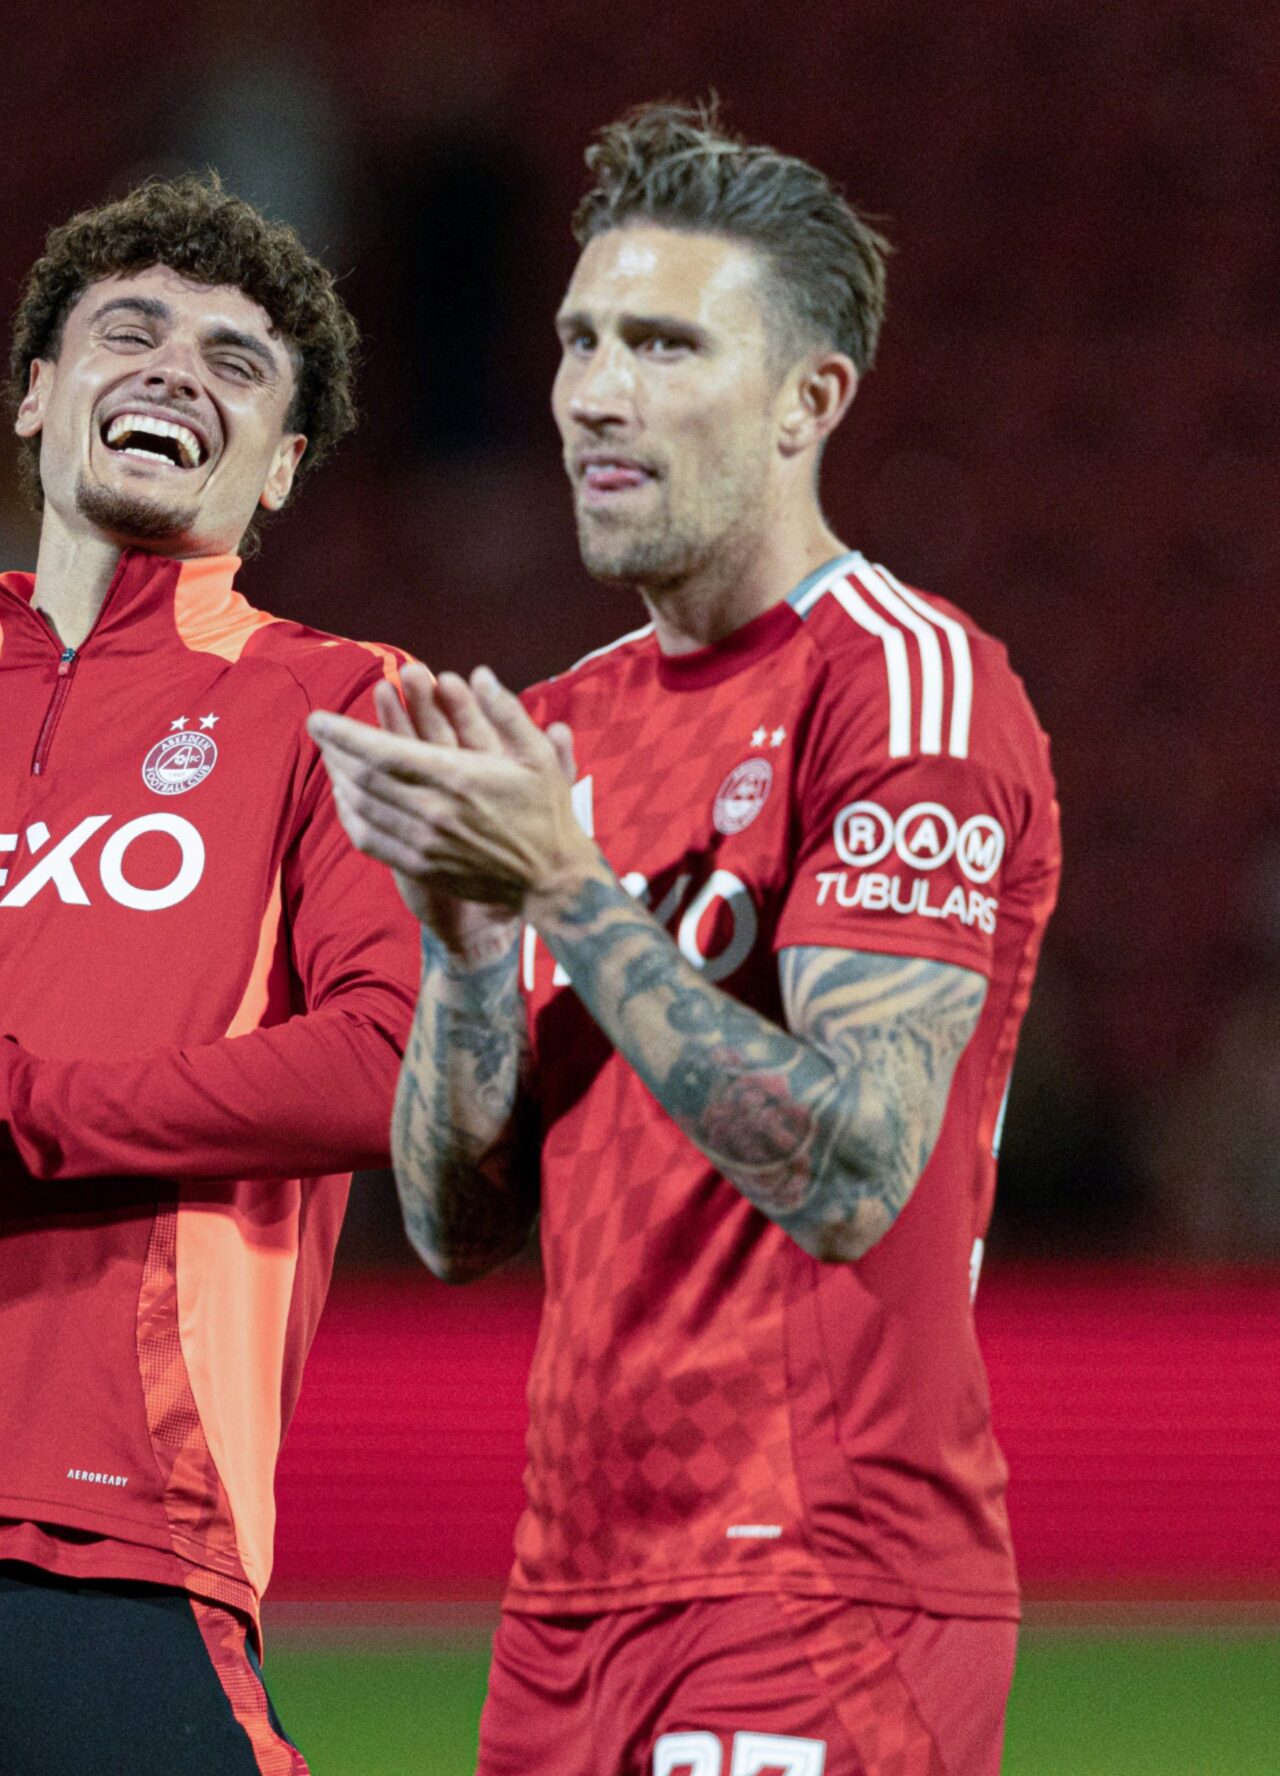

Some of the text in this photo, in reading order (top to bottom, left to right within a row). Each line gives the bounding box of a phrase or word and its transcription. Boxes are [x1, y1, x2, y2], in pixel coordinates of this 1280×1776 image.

[161, 734, 212, 752] ABERDEEN
[146, 764, 211, 792] FOOTBALL CLUB
[815, 872, 999, 935] TUBULARS
[67, 1468, 129, 1488] AEROREADY
